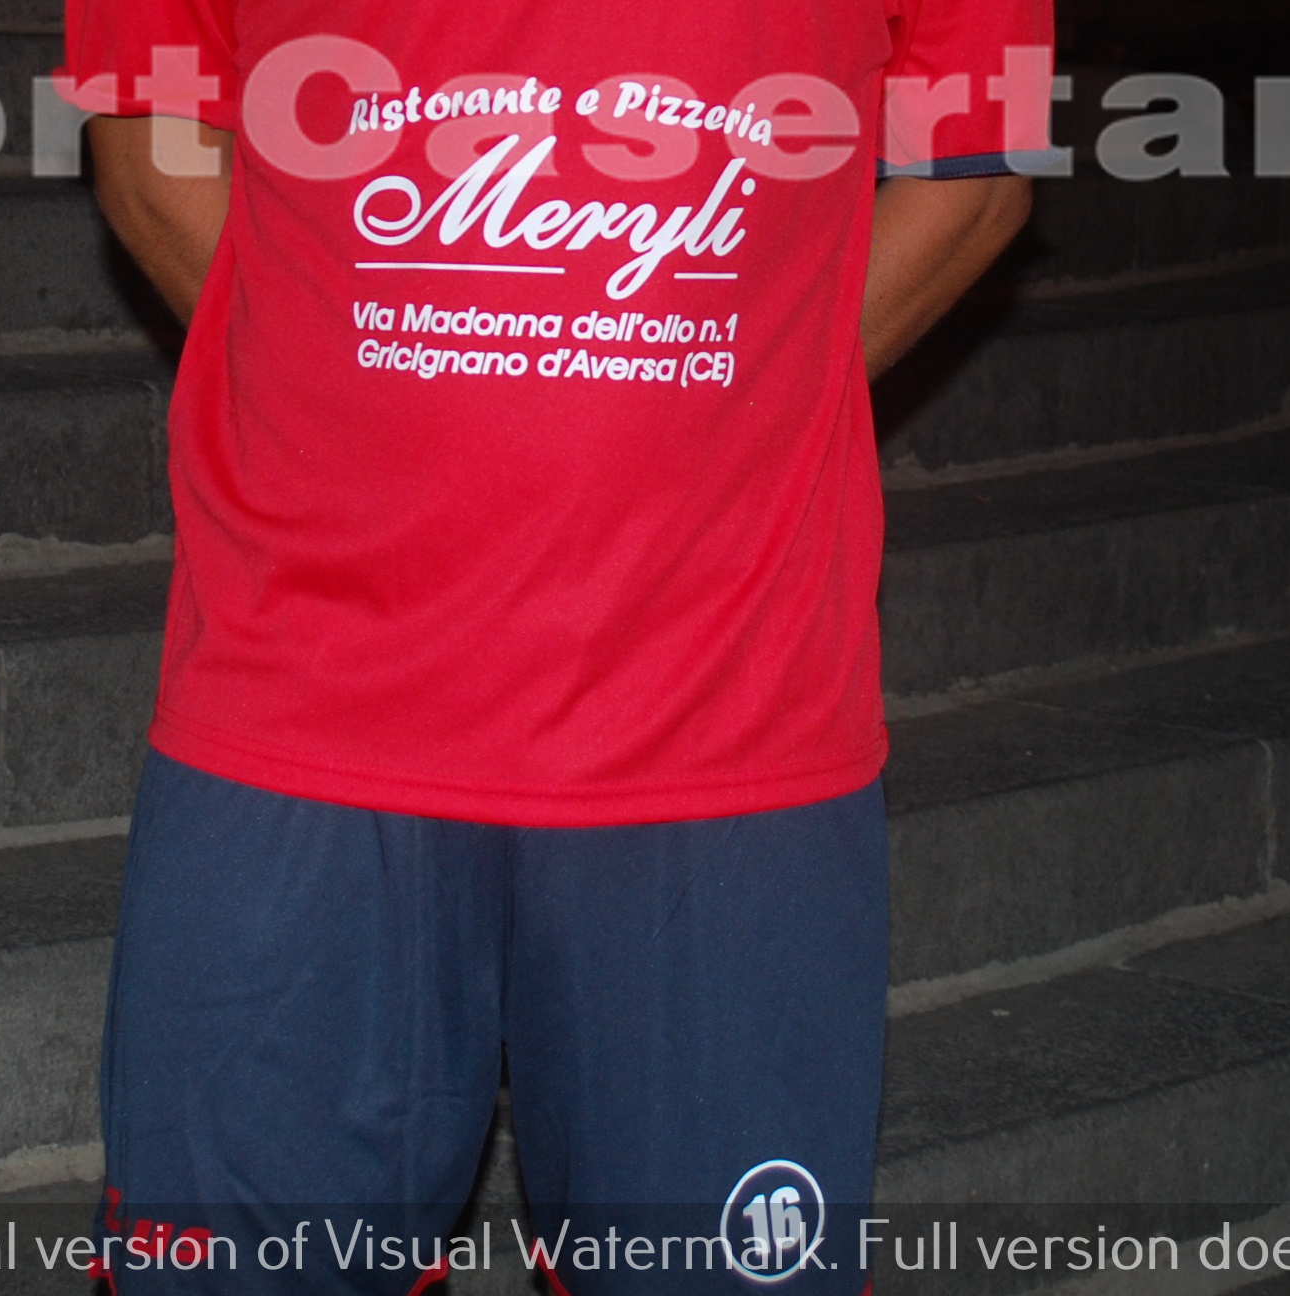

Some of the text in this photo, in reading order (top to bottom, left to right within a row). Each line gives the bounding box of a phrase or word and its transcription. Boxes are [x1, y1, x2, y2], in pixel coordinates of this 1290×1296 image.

[349, 77, 773, 146] Ristorante e Pizzeria
[353, 134, 757, 300] Meryli
[353, 302, 395, 331] Via
[401, 304, 563, 339] Madonna
[698, 314, 739, 342] n.1
[357, 339, 735, 388] Gricignano d'Aversa (CE)
[742, 1185, 803, 1256] 16
